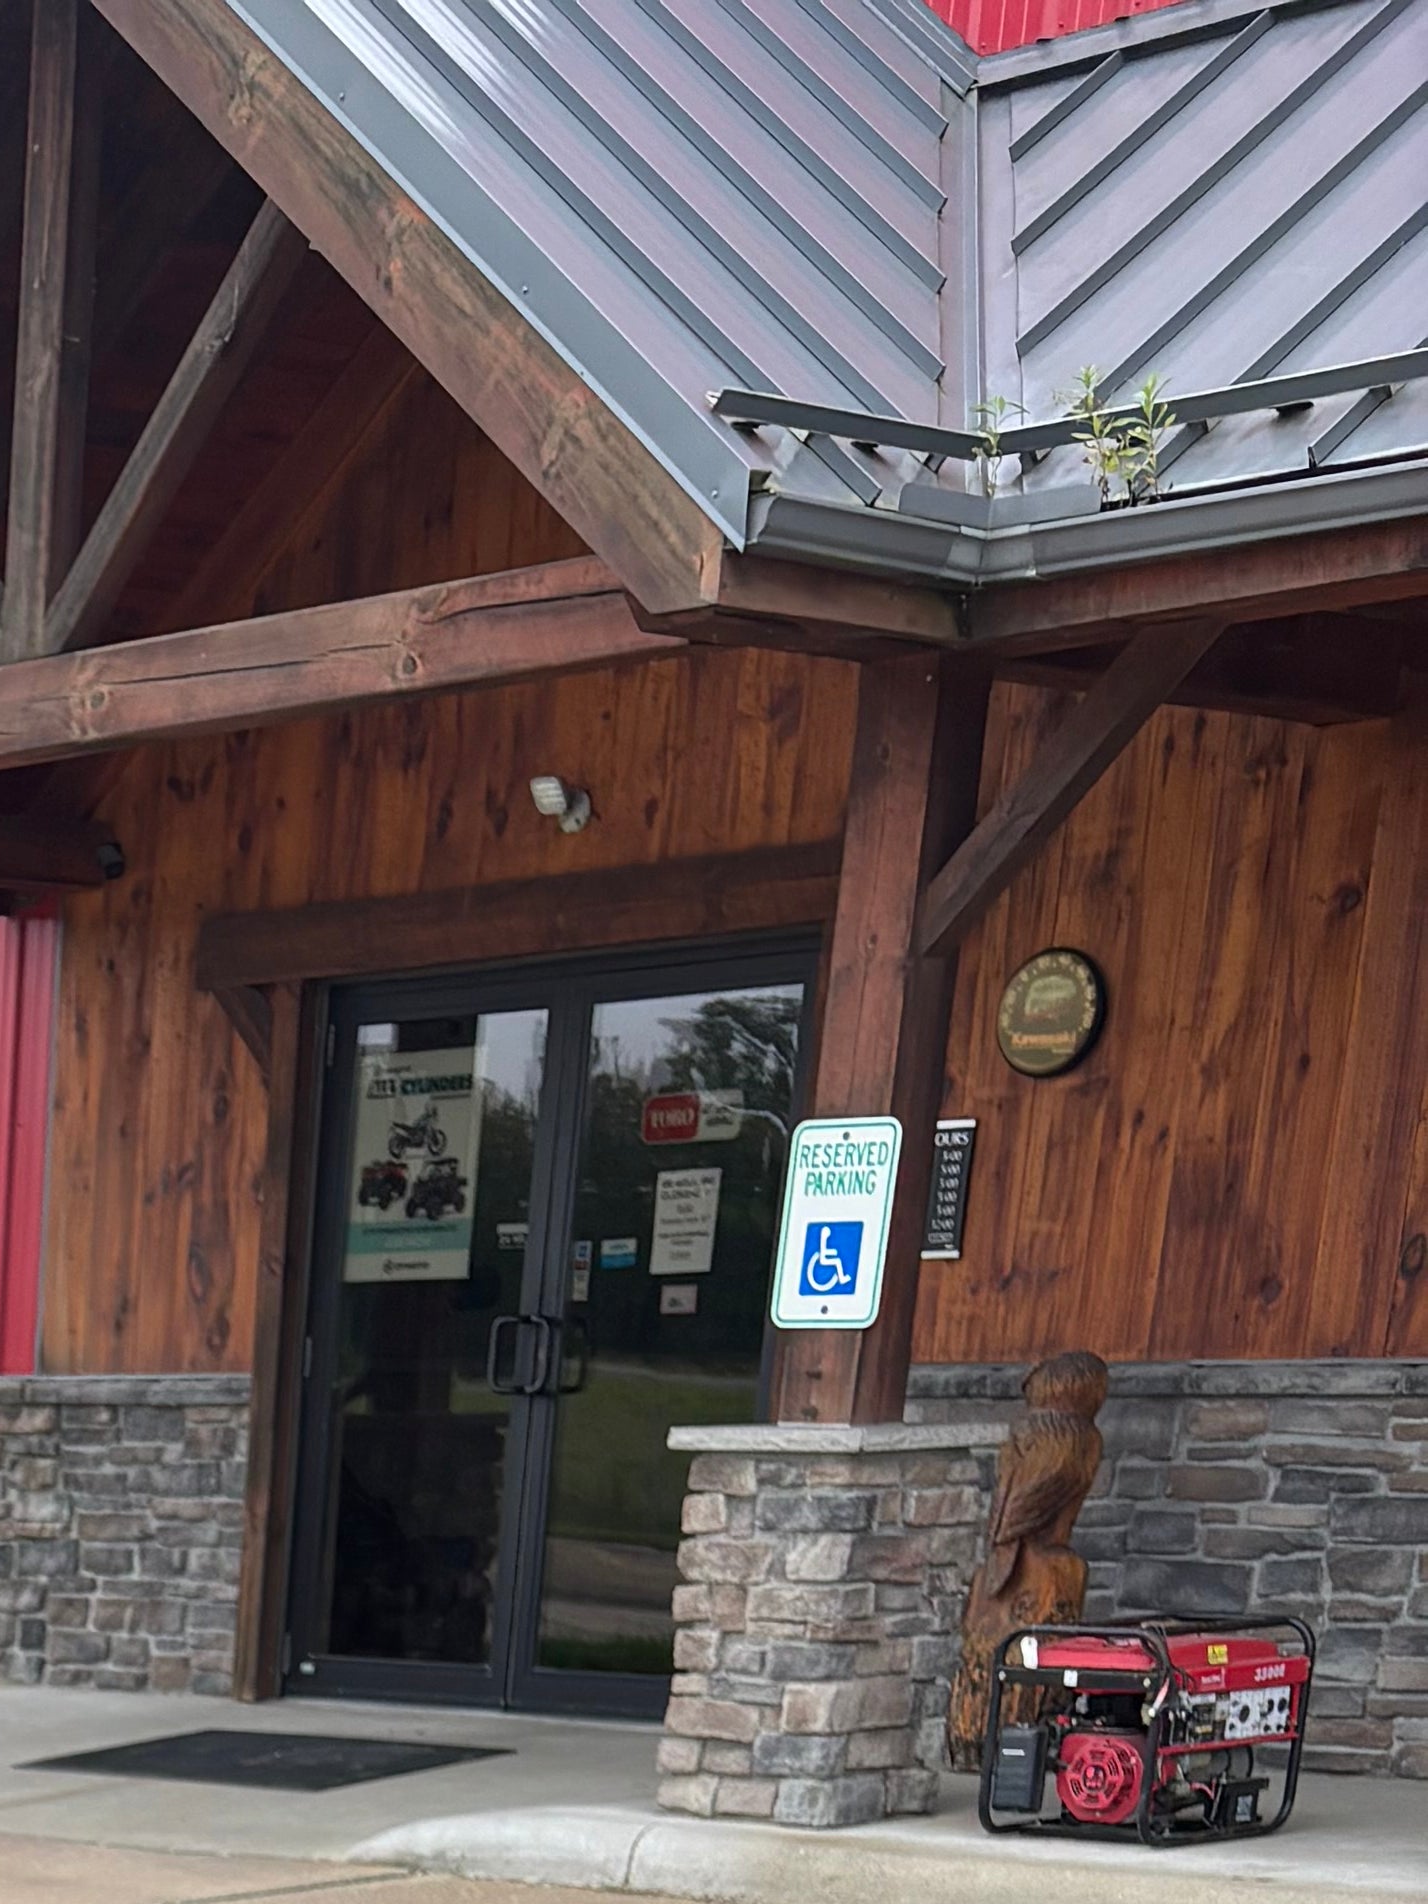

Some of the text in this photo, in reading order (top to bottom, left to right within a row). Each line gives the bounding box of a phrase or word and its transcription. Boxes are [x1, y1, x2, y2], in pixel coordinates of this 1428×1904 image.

[934, 1132, 969, 1147] OURS
[799, 1141, 889, 1169] RESERVED
[804, 1170, 879, 1196] PARKING
